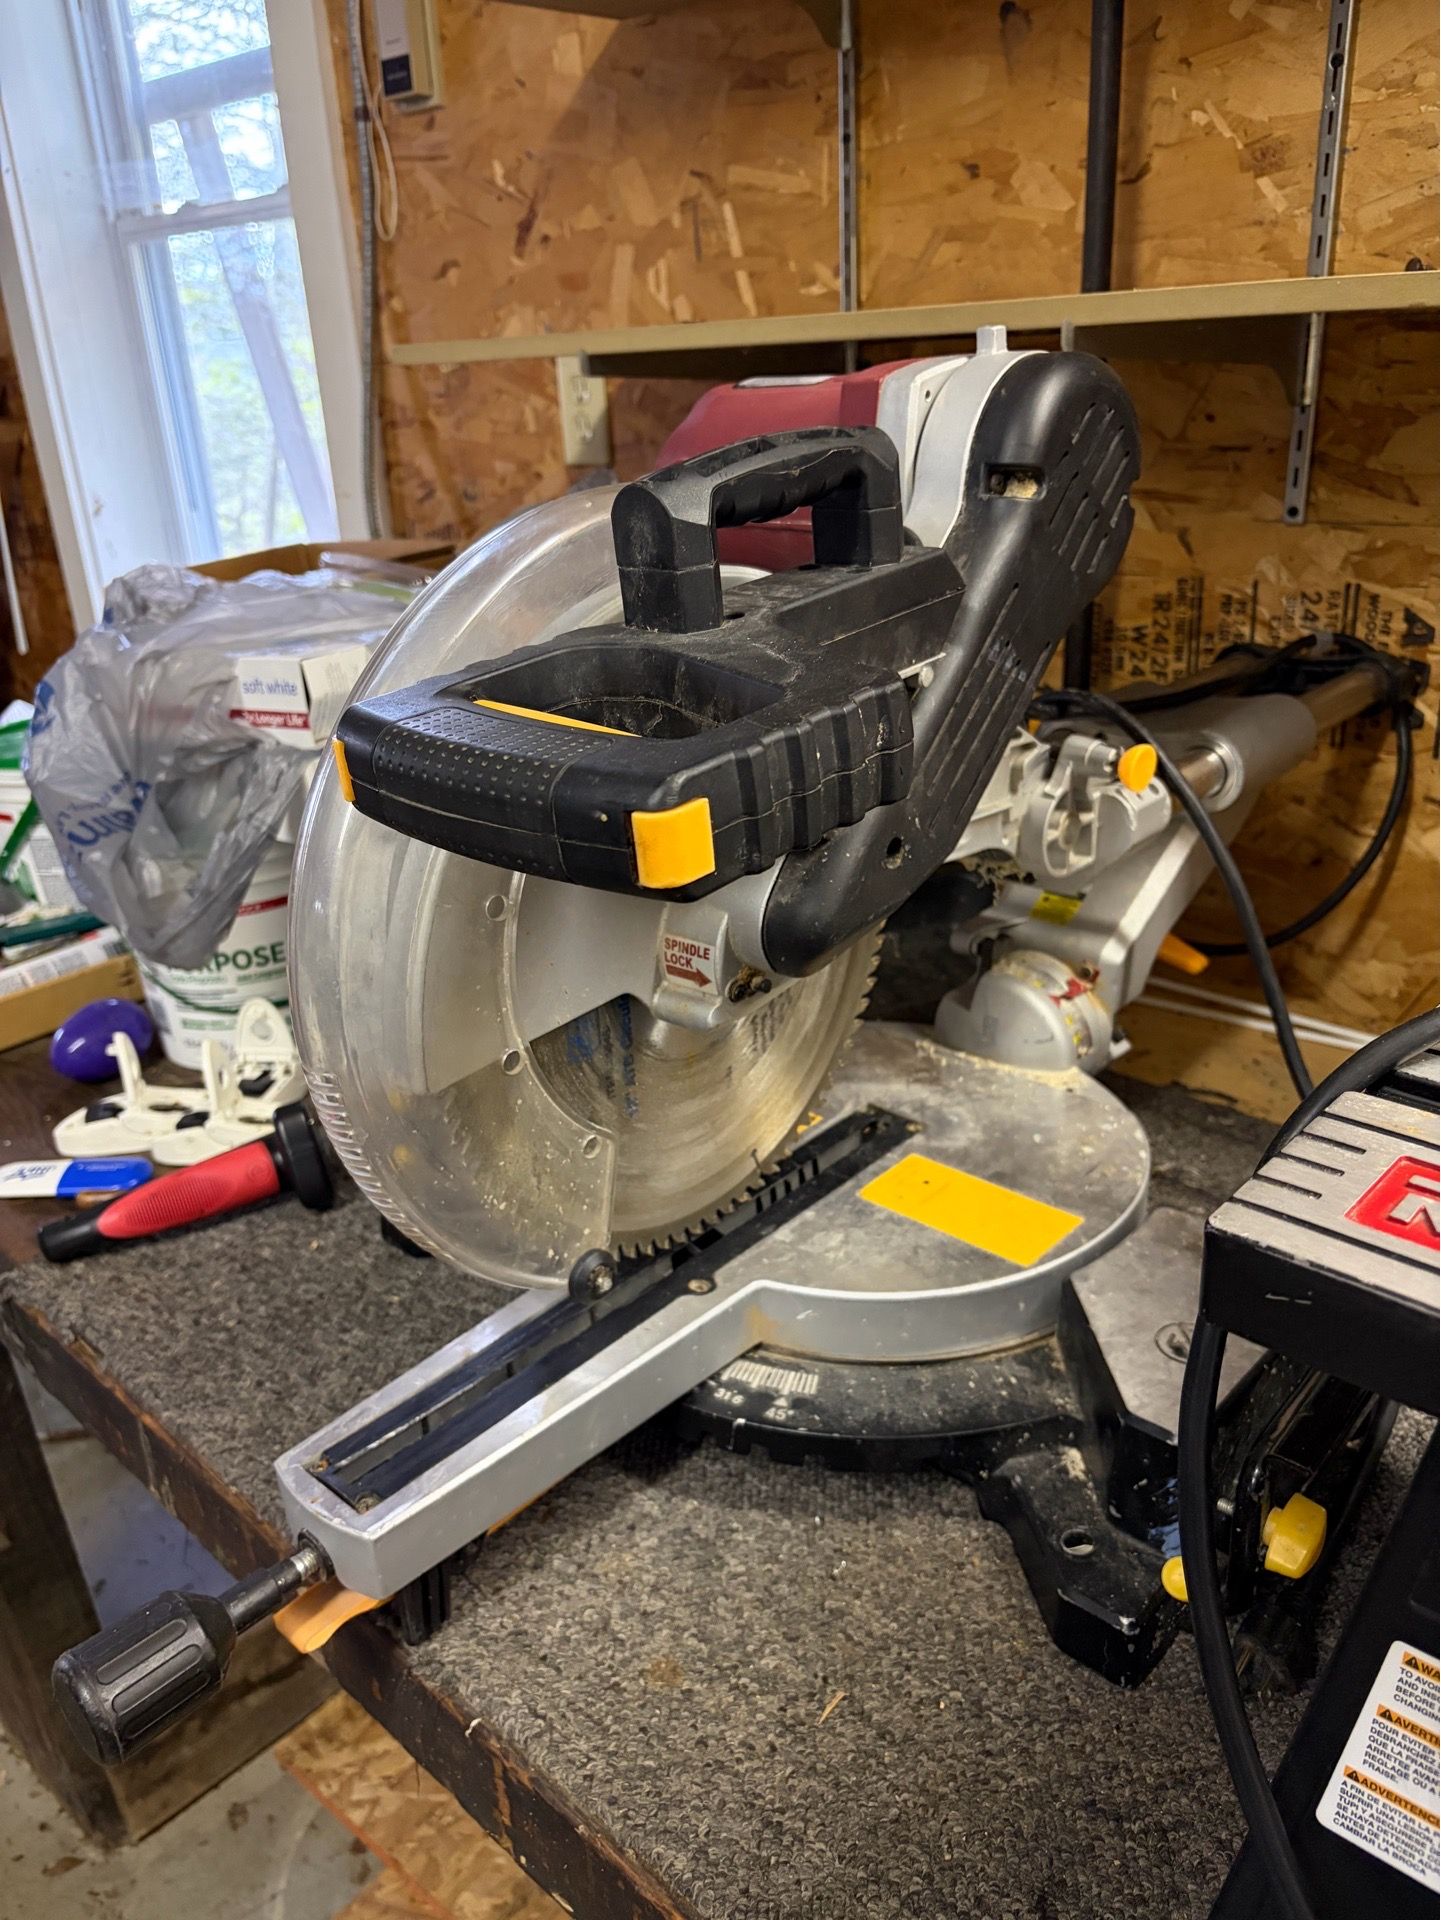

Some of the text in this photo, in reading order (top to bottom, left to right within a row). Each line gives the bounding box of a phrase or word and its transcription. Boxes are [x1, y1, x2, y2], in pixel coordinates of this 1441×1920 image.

[242, 678, 298, 697] soft white
[664, 937, 710, 960] SPINDLE
[664, 951, 694, 970] LOCK
[1398, 1676, 1418, 1691] AND
[1399, 1666, 1412, 1679] TO
[1396, 1684, 1435, 1710] BEFORE
[1368, 1734, 1387, 1749] QUE
[1391, 1746, 1403, 1758] LA
[1370, 1726, 1435, 1765] DEBRANCHEZ
[1372, 1718, 1435, 1757] POUR EVITER
[1364, 1750, 1435, 1794] REGLAGE OU A
[1367, 1743, 1409, 1771] ARRETEE
[1337, 1793, 1358, 1810] TUPI
[1369, 1812, 1426, 1848] ASEGURESE
[1340, 1786, 1373, 1810] SUFRIR
[1375, 1807, 1395, 1822] UNA
[1342, 1779, 1348, 1788] A
[1350, 1784, 1364, 1797] FIN
[1367, 1793, 1379, 1805] DE
[1382, 1802, 1415, 1825] EVITAR
[1418, 1822, 1430, 1833] LA
[1333, 1817, 1425, 1875] CAMBIAR LA BROCA
[1335, 1810, 1364, 1831] ANTES
[1367, 1828, 1380, 1840] DE
[1382, 1837, 1415, 1860] HACER
[1336, 1802, 1348, 1813] SE
[1350, 1810, 1374, 1828] HAYA
[1377, 1825, 1424, 1857] DETENIDO
